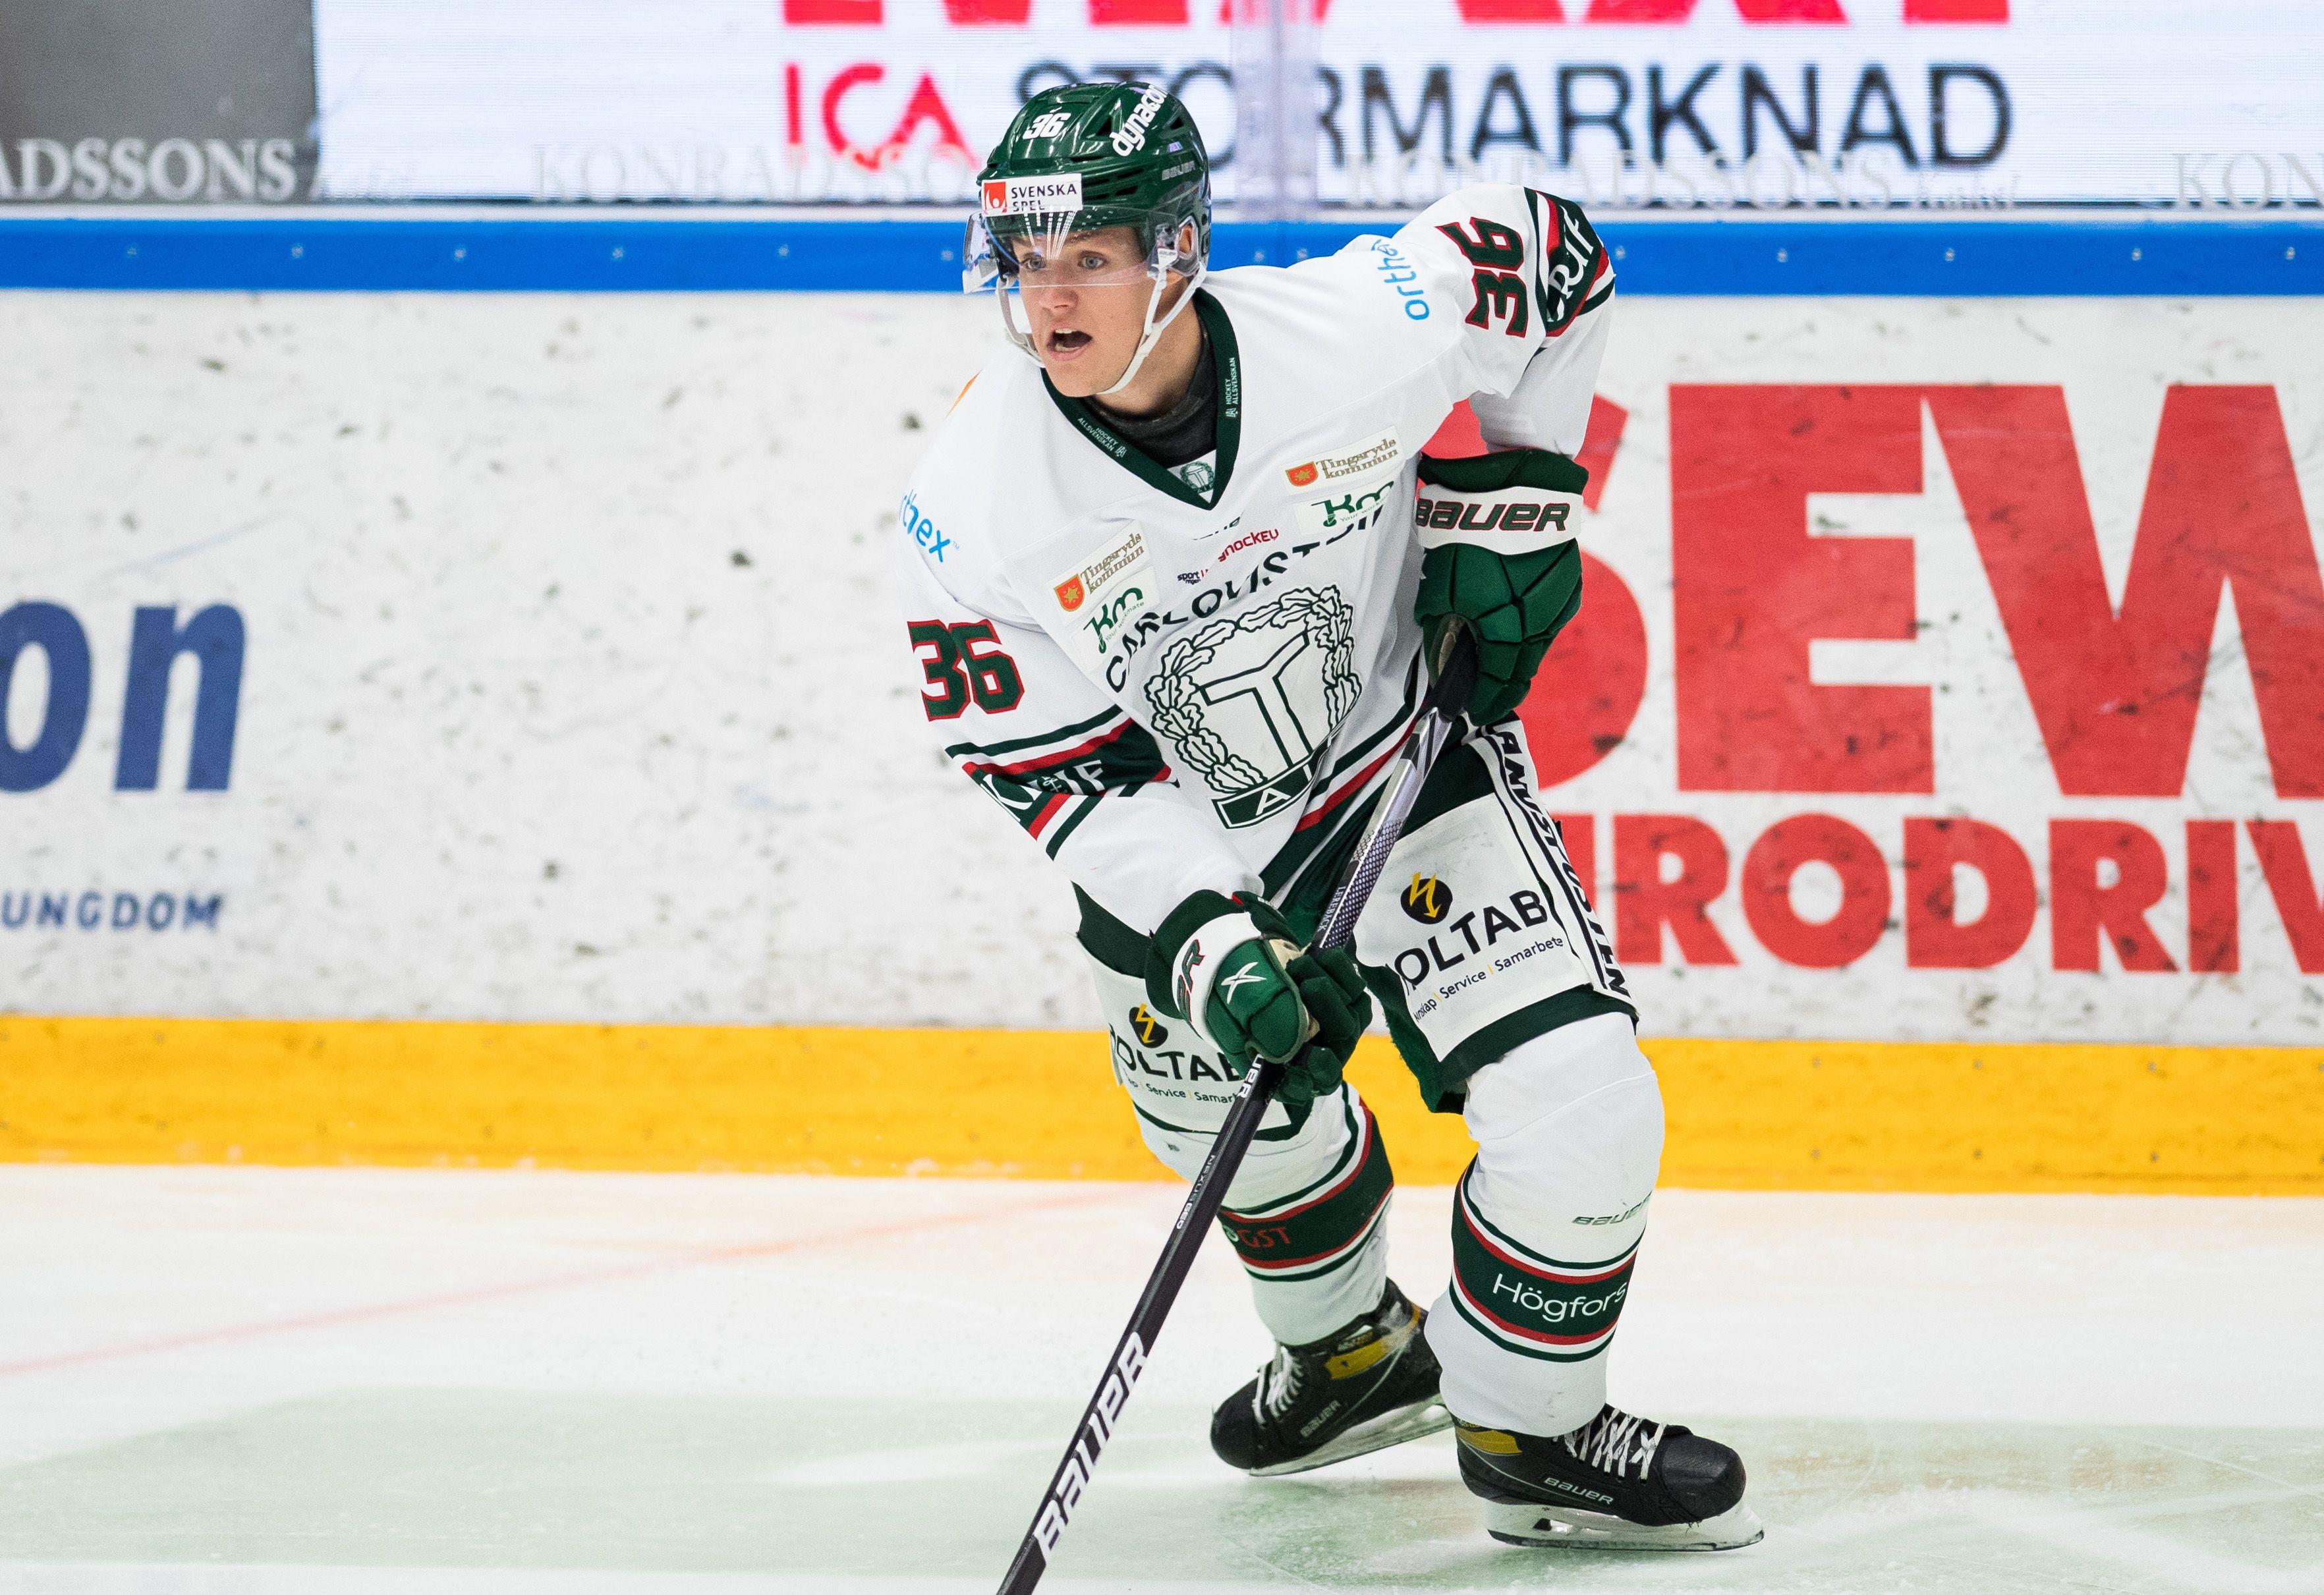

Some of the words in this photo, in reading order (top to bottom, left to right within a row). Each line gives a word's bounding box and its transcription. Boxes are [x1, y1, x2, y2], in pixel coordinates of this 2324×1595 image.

[784, 63, 980, 171] ICA
[1016, 61, 2013, 171] ORMARKNAD
[1023, 111, 1071, 140] 36
[532, 145, 982, 206] KONRADSSO
[1011, 183, 1078, 199] SVENSKA
[1012, 200, 1045, 212] SPEL
[1434, 216, 1529, 339] 36
[1230, 356, 1239, 405] ALLSVENSKAN
[1077, 417, 1114, 452] ALLSVENSKAN
[1096, 427, 1119, 446] HOCKEY
[1315, 438, 1396, 470] Tingsryds
[1323, 449, 1399, 479] kommun
[1415, 498, 1570, 532] BAUER
[1080, 533, 1142, 584] Tingsryds
[1087, 546, 1145, 596] kommun
[1083, 587, 1144, 654] Km
[907, 618, 1025, 722] 36
[1, 889, 225, 932] UNGDOM
[1394, 889, 1549, 996] OLTAB
[1438, 969, 1487, 999] Service
[1494, 936, 1564, 972] Samarbete
[1109, 1023, 1243, 1082] OLTA
[1237, 1053, 1264, 1100] UER
[1146, 1082, 1186, 1098] Service
[1492, 1273, 1628, 1323] Högfors
[1033, 1331, 1148, 1566] BAUER
[1544, 1476, 1614, 1505] BAUER
